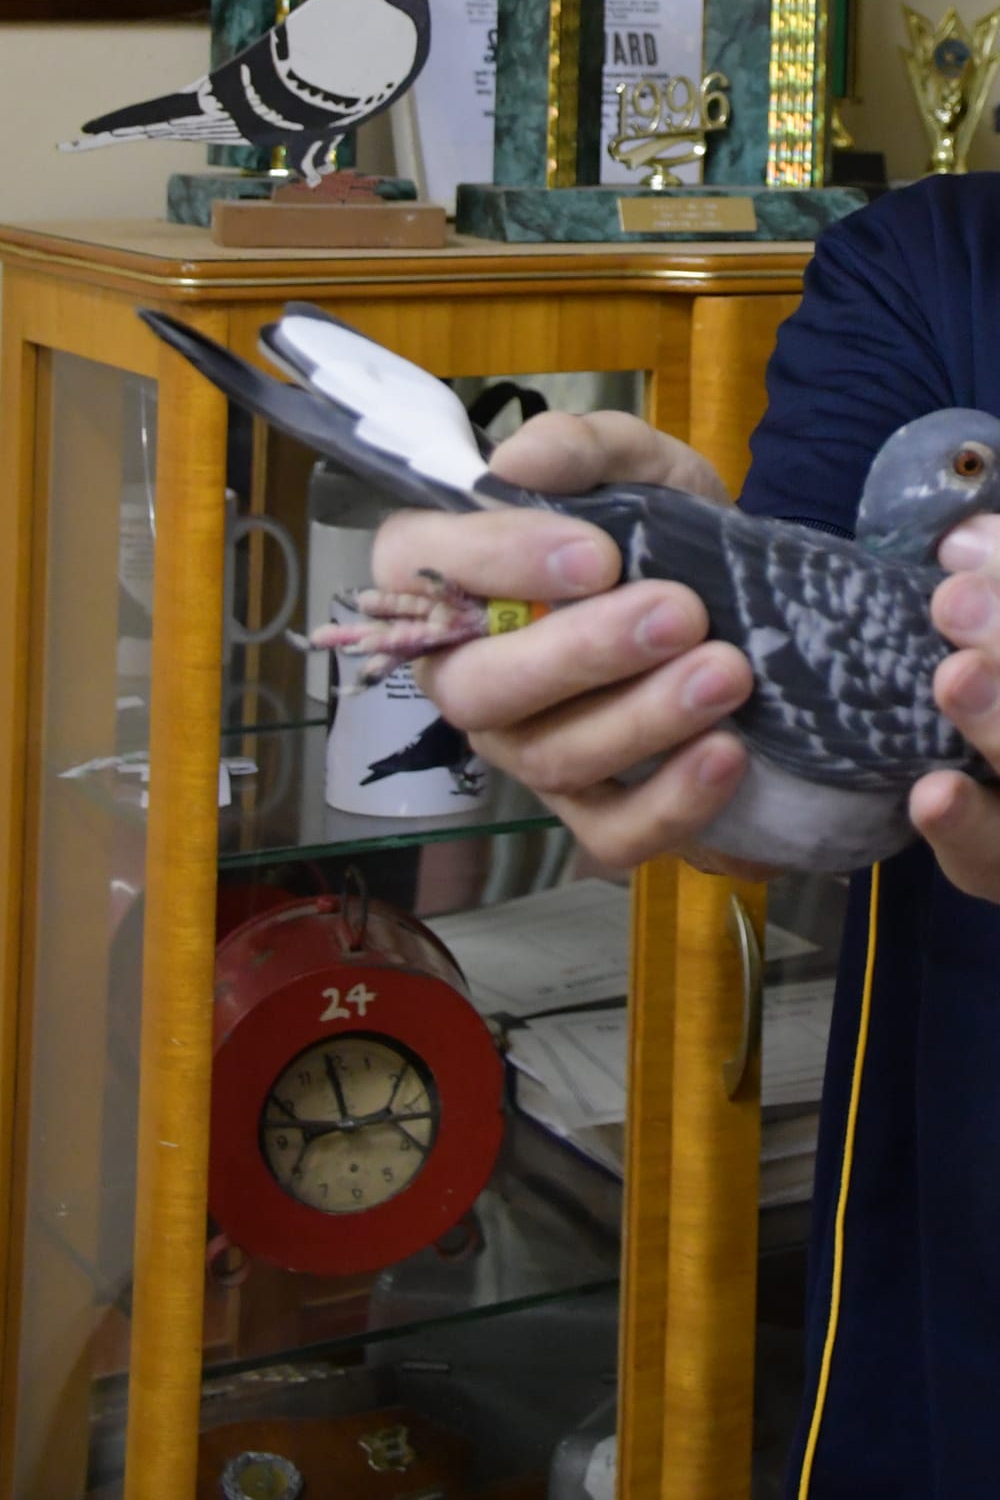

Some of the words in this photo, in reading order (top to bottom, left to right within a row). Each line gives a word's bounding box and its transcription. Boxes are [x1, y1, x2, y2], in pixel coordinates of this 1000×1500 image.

[607, 31, 658, 67] ARD
[616, 71, 731, 137] 1996
[320, 982, 377, 1022] 24
